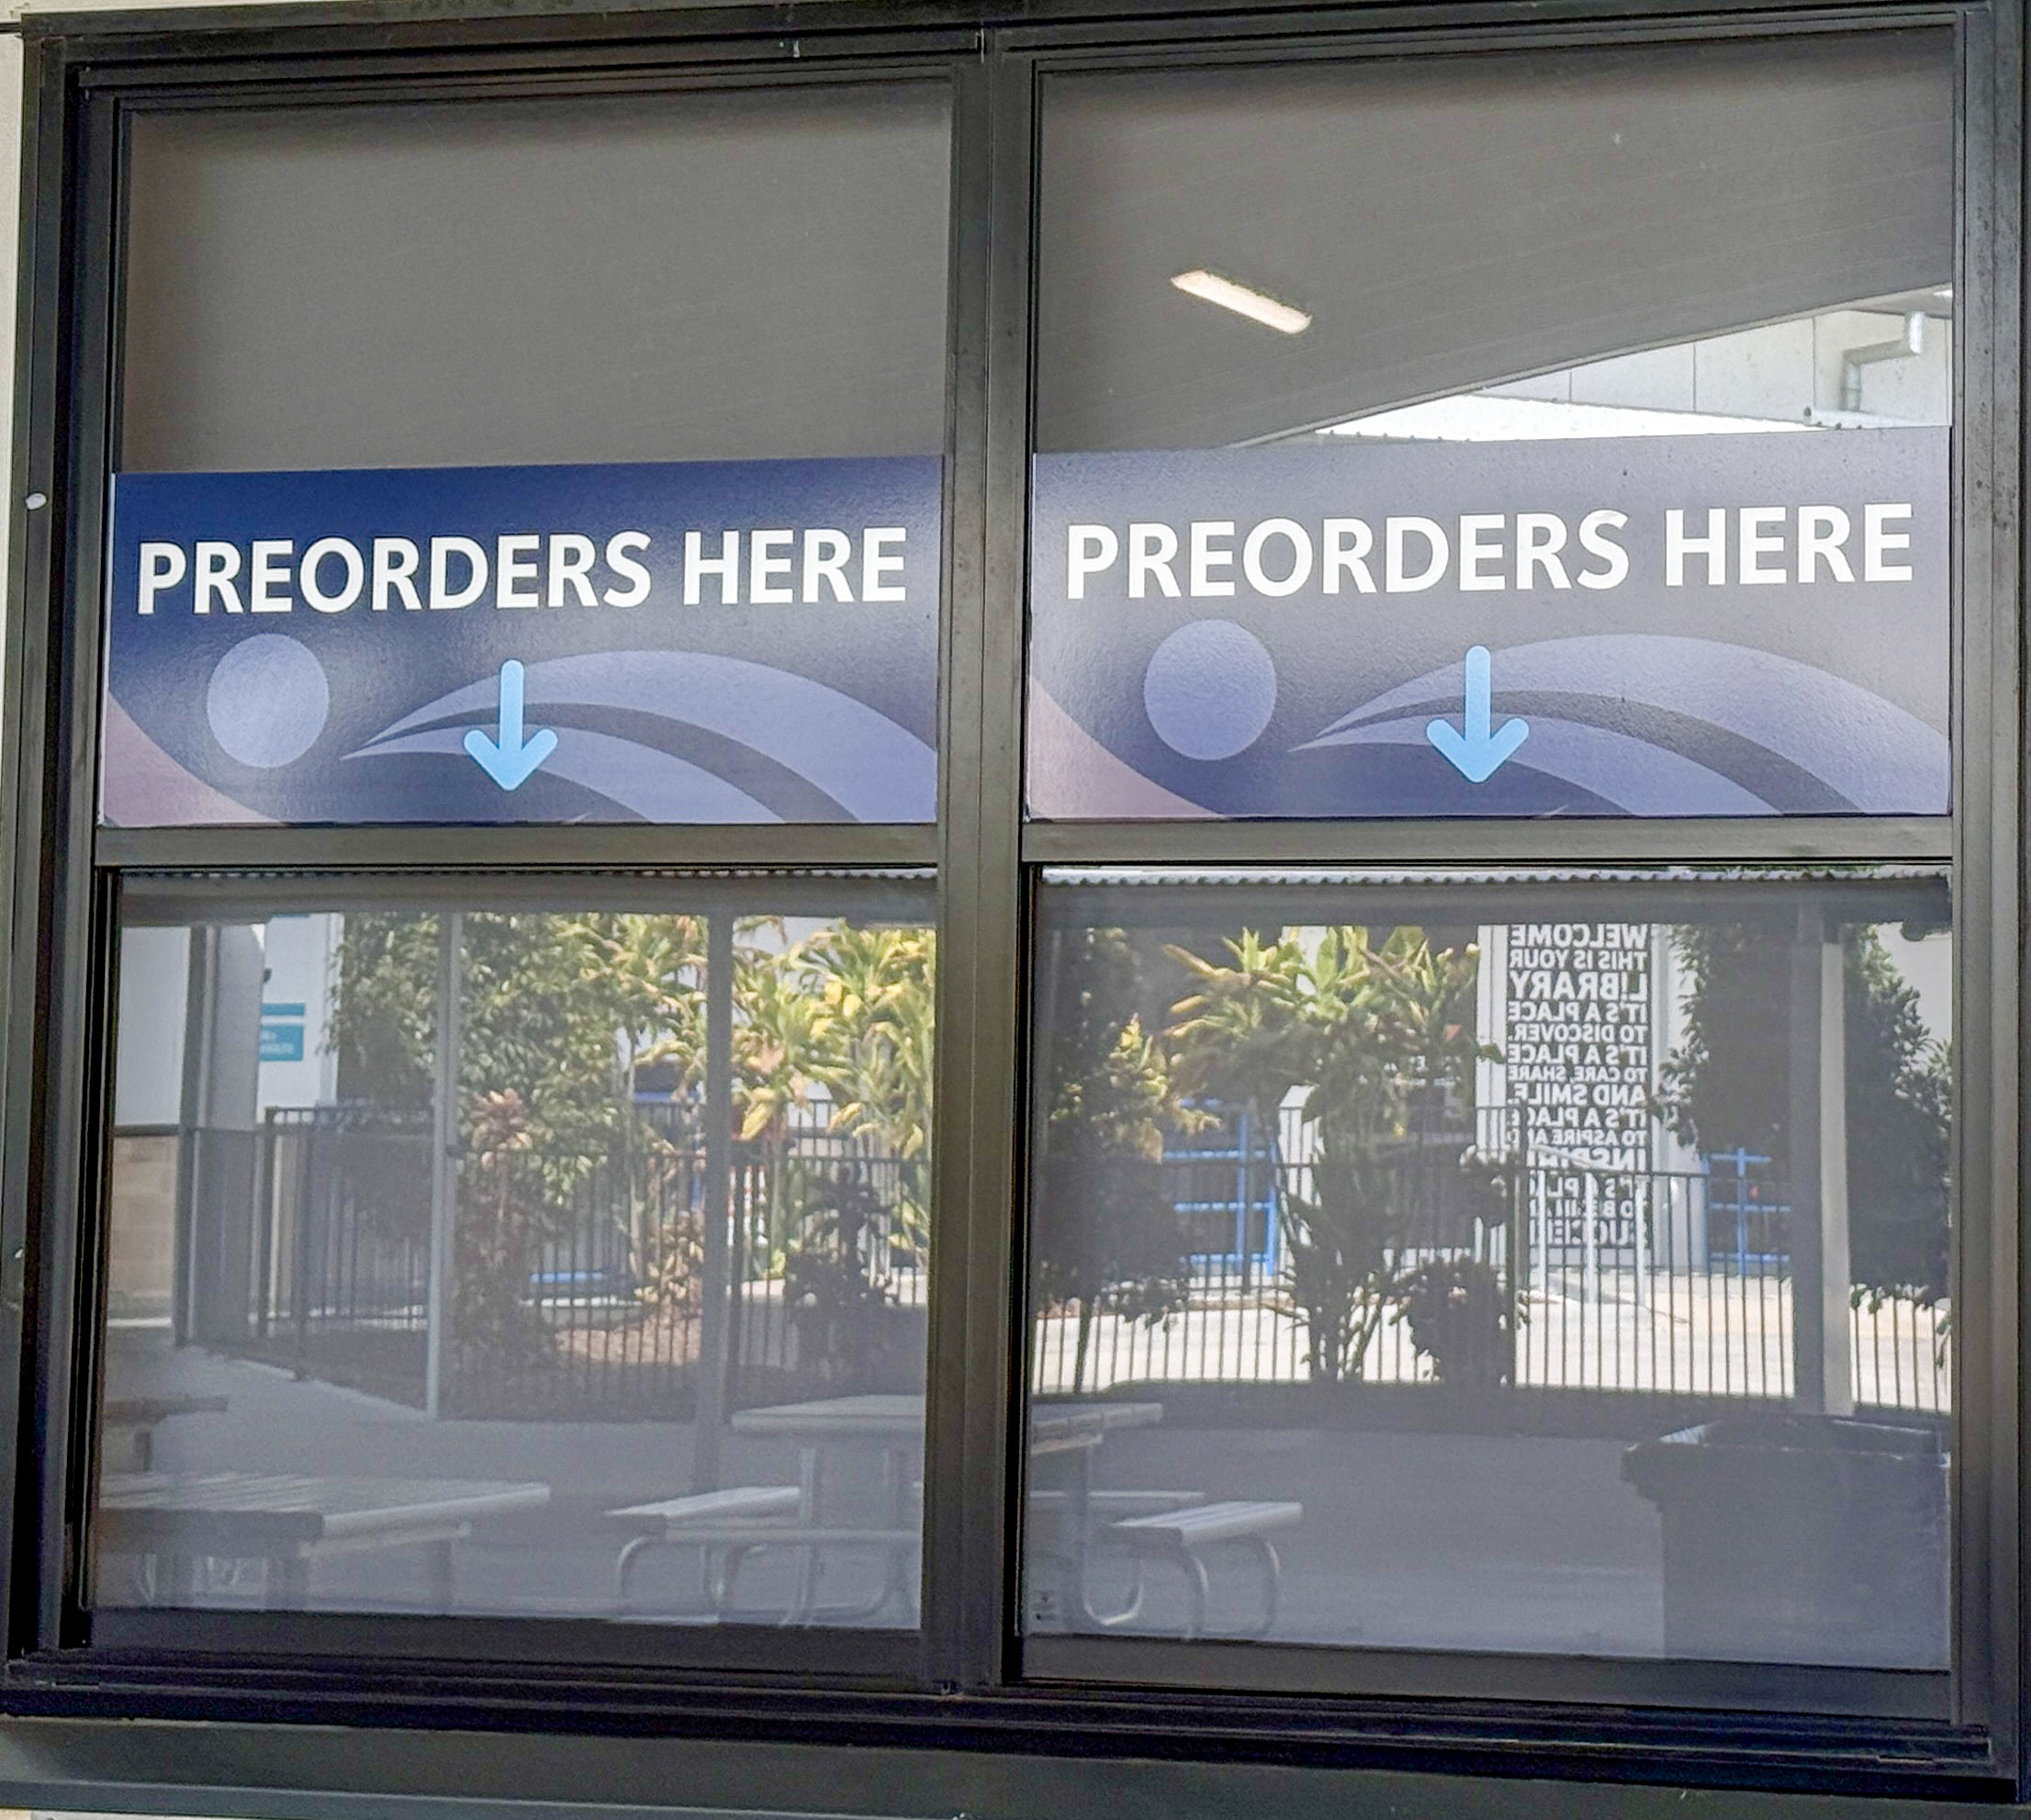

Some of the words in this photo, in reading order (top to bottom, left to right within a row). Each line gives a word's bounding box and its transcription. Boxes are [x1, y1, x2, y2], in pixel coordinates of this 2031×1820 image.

[137, 530, 652, 614] PREORDERS
[682, 527, 908, 606] HERE
[1068, 509, 1630, 600] PREORDERS
[1665, 502, 1913, 587] HERE
